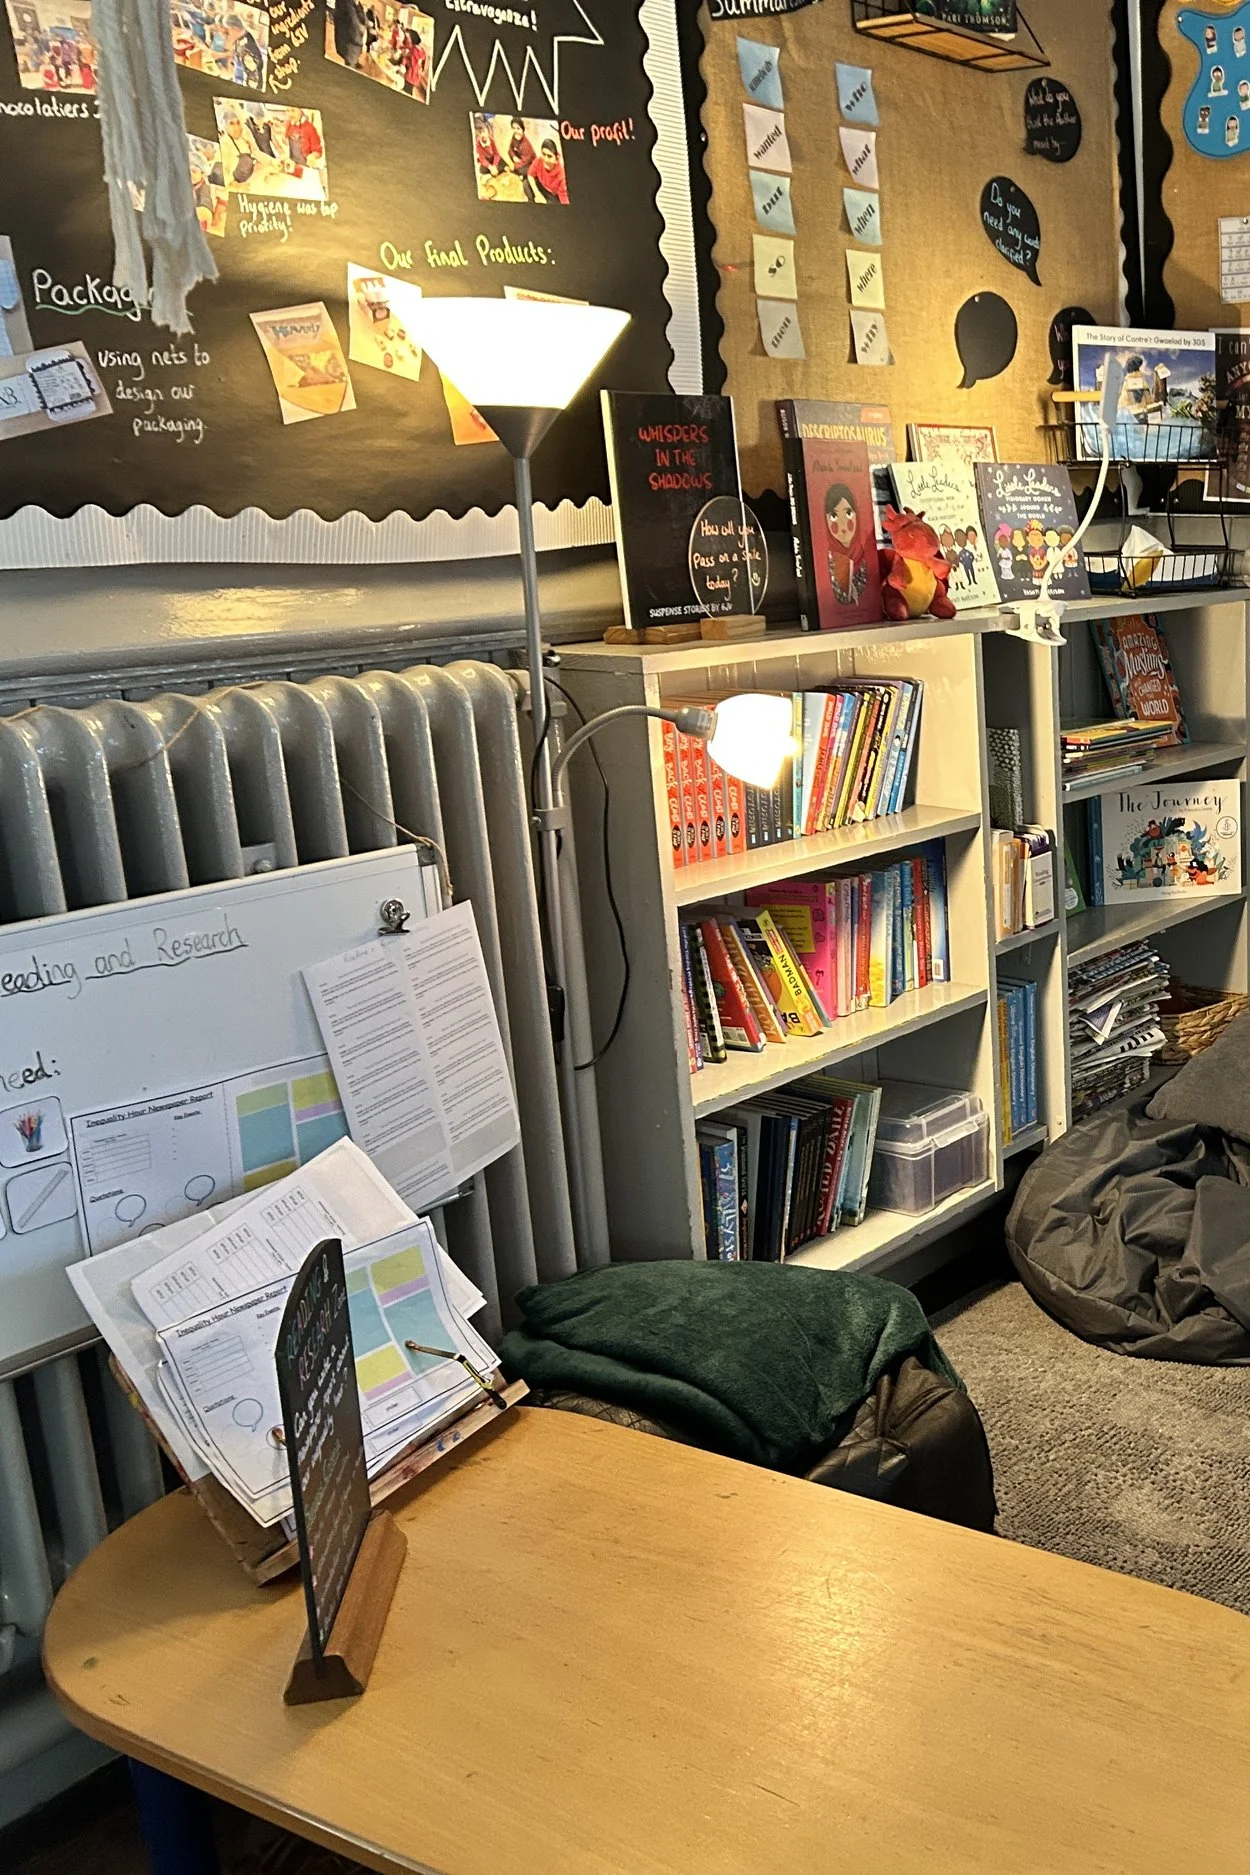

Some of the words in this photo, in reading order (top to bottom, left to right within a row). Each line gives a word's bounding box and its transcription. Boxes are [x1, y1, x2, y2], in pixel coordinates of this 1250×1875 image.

[0, 96, 90, 118] ocolatiers
[845, 81, 867, 112] who
[561, 120, 585, 141] Our
[753, 124, 783, 160] wanted
[852, 144, 871, 176] what
[762, 186, 783, 216] but
[991, 182, 1004, 207] Do
[1006, 202, 1021, 223] you
[855, 203, 876, 236] when
[983, 211, 1004, 232] need
[380, 241, 413, 271] Our
[476, 235, 556, 266] Products:
[767, 255, 786, 278] so
[857, 262, 876, 293] where
[32, 268, 155, 322] Packag
[771, 316, 791, 349] then
[861, 320, 880, 354] why
[1086, 333, 1099, 341] The
[1100, 333, 1116, 343] Story
[1118, 334, 1126, 342] of
[1183, 338, 1191, 347] by
[151, 344, 188, 367] nets
[194, 343, 211, 366] to
[115, 380, 164, 414] design
[638, 423, 710, 444] WHISPERS
[655, 449, 670, 467] IN
[673, 448, 697, 467] THE
[648, 471, 712, 491] SHADOWS
[907, 469, 931, 499] Little
[993, 470, 1025, 498] Little
[1023, 468, 1062, 498] Leaders
[701, 520, 719, 537] How
[738, 524, 755, 549] you
[718, 552, 730, 564] on
[732, 552, 739, 562] a
[649, 605, 683, 618] SUSPENSE
[711, 603, 721, 612] BY
[1122, 634, 1159, 651] AMAZING
[1123, 647, 1169, 681] Muslims
[1141, 699, 1170, 717] WORLD
[1114, 791, 1146, 813] The
[1151, 790, 1228, 815] Journey
[0, 955, 82, 1000] eading
[95, 937, 136, 975] and
[152, 913, 245, 962] Research
[778, 954, 802, 997] BADMAN
[127, 1108, 147, 1120] Hour
[148, 1097, 189, 1114] Newspaper
[190, 1091, 214, 1104] Report
[176, 1318, 212, 1338] Inequality
[212, 1311, 230, 1323] Hour
[265, 1285, 288, 1300] Report
